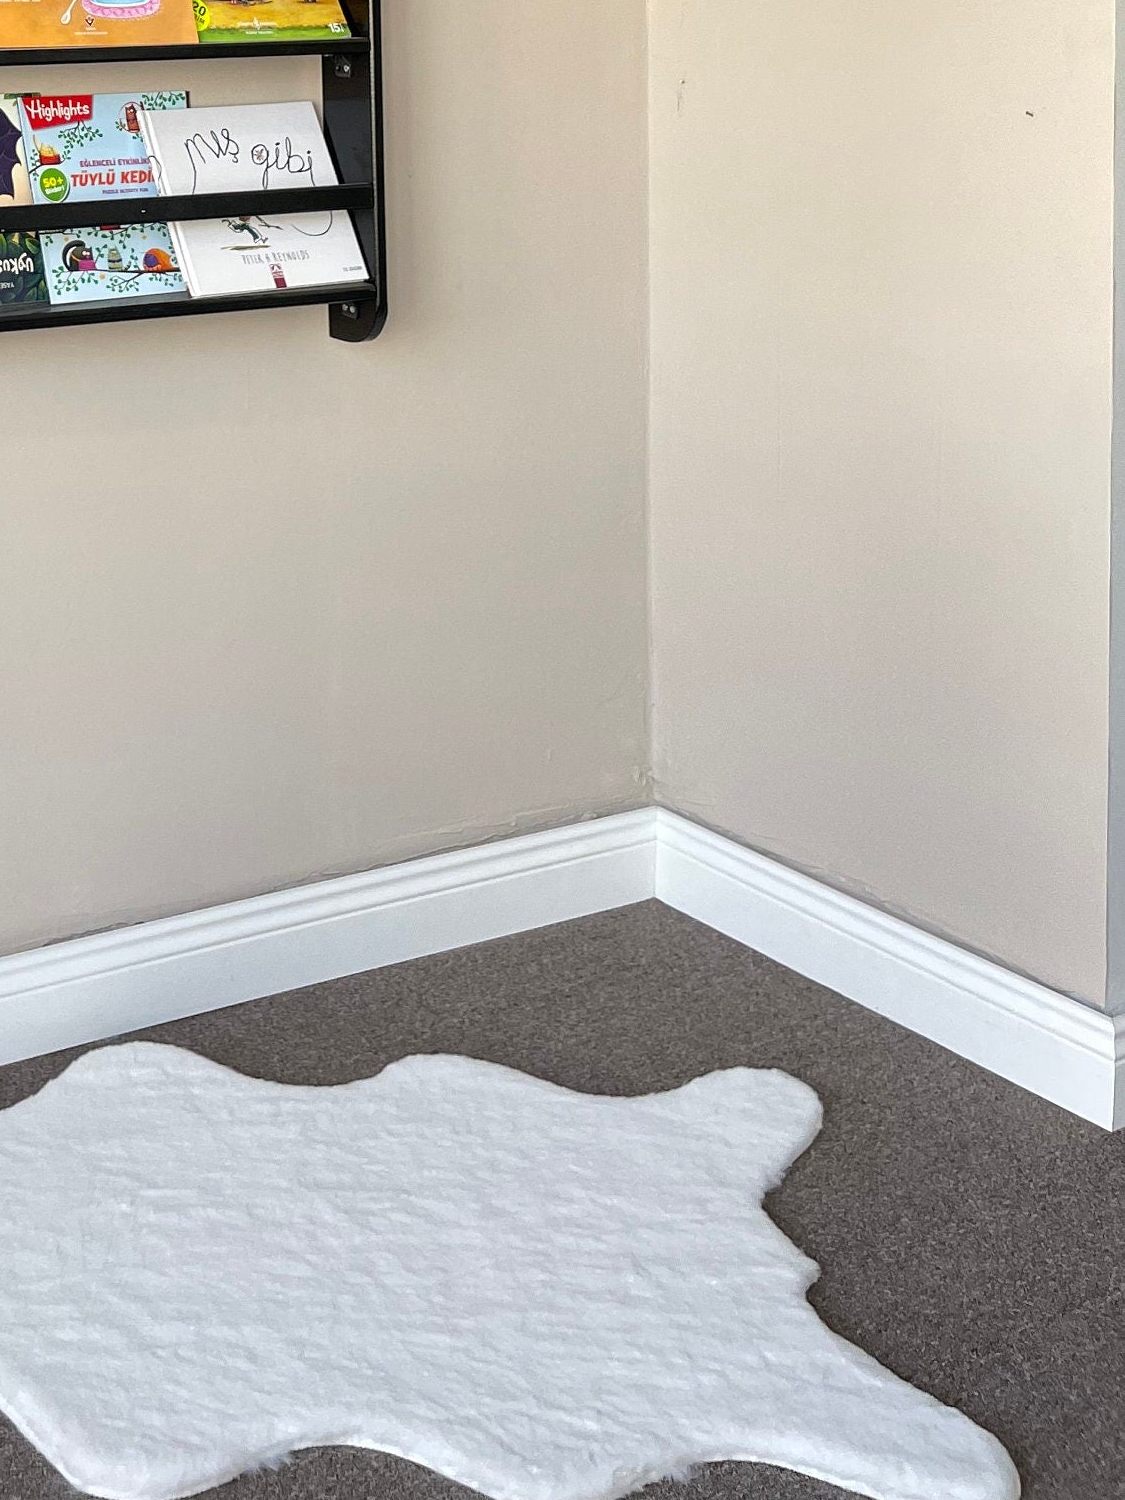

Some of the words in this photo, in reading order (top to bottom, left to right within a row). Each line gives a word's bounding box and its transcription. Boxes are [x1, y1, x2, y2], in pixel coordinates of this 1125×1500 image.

[25, 99, 90, 122] Highlights
[42, 176, 63, 188] 50+
[71, 169, 116, 187] TÜYLÜ
